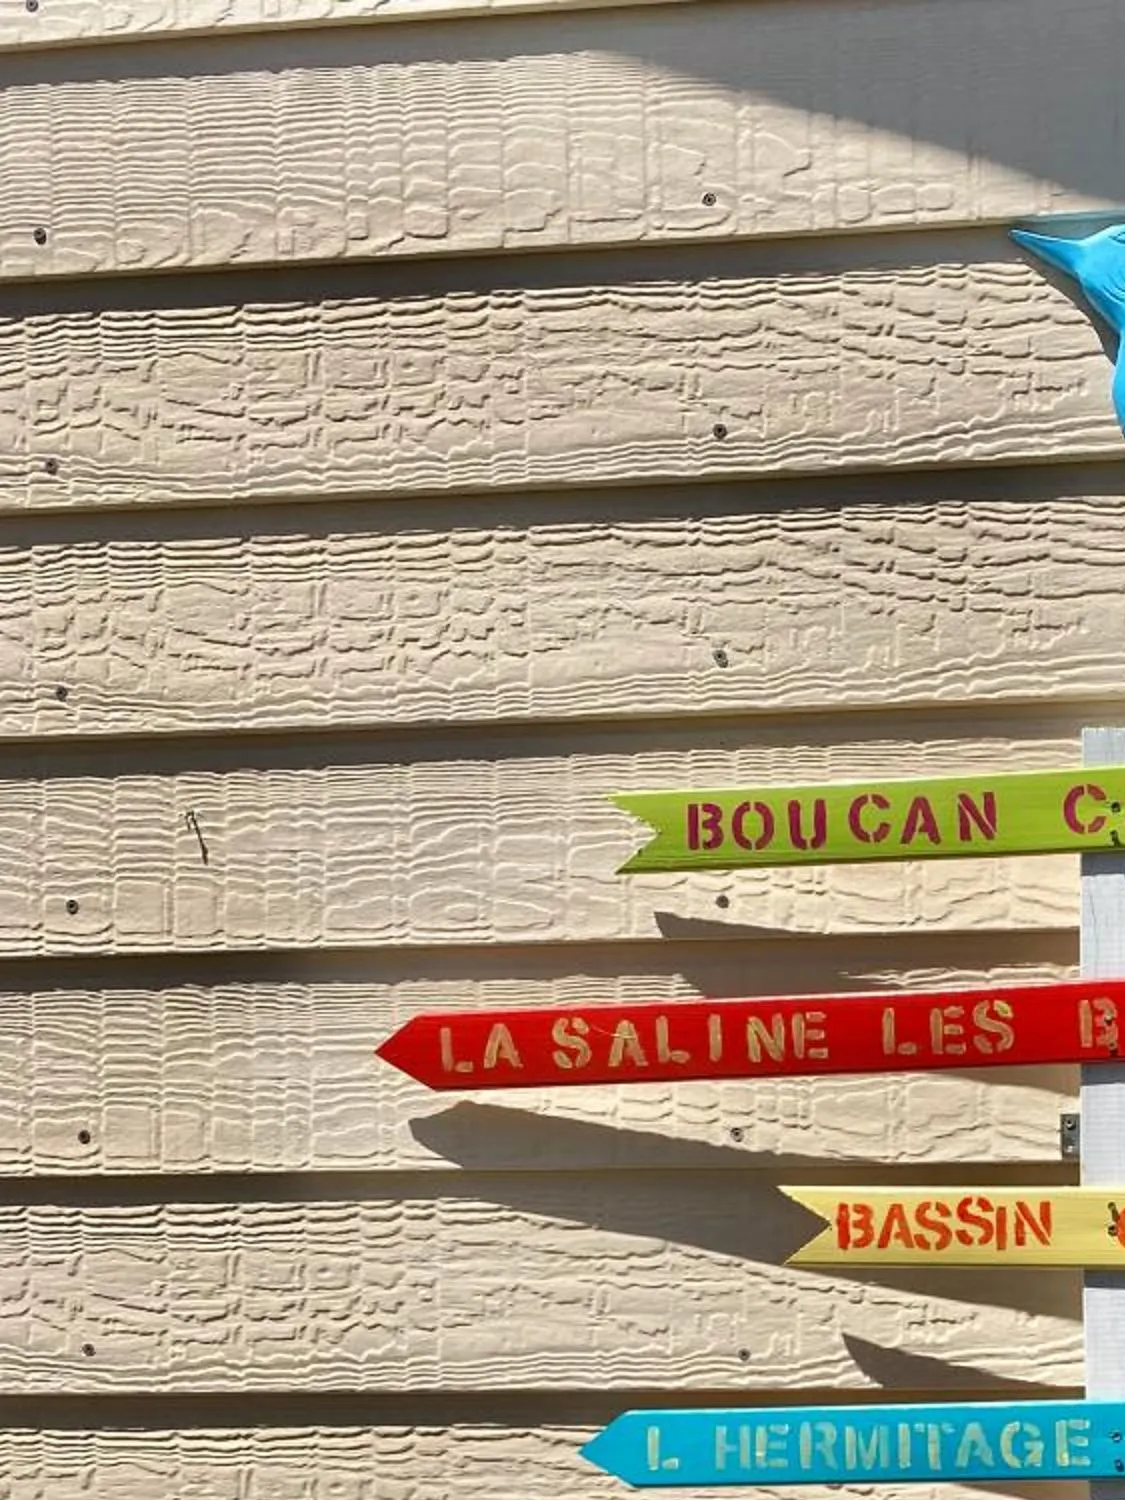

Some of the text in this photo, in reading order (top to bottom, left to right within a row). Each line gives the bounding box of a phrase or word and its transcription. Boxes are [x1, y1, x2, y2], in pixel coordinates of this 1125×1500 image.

[687, 792, 997, 850] BOUCAN
[440, 1023, 523, 1072] LA
[552, 1010, 829, 1068] SALINE
[882, 1000, 1014, 1055] LES
[836, 1197, 1052, 1252] BASSIN
[647, 1426, 678, 1470] L
[714, 1418, 1091, 1470] HERMITAGE
